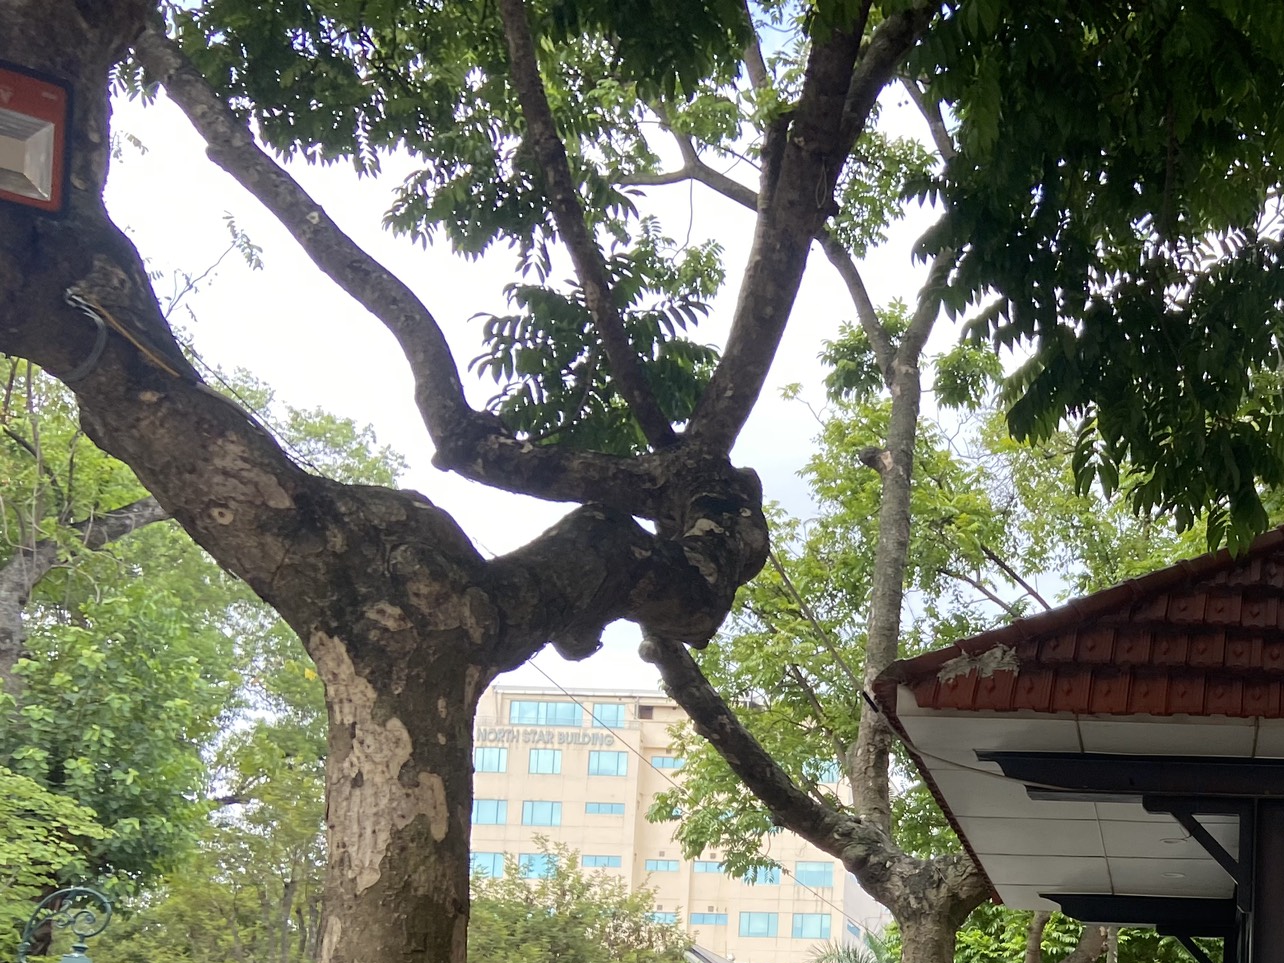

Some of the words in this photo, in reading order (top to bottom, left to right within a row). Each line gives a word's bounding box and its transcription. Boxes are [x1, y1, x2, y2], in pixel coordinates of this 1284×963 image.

[476, 728, 520, 744] NORTH
[521, 729, 555, 745] STAR
[557, 731, 615, 747] BUILDING
